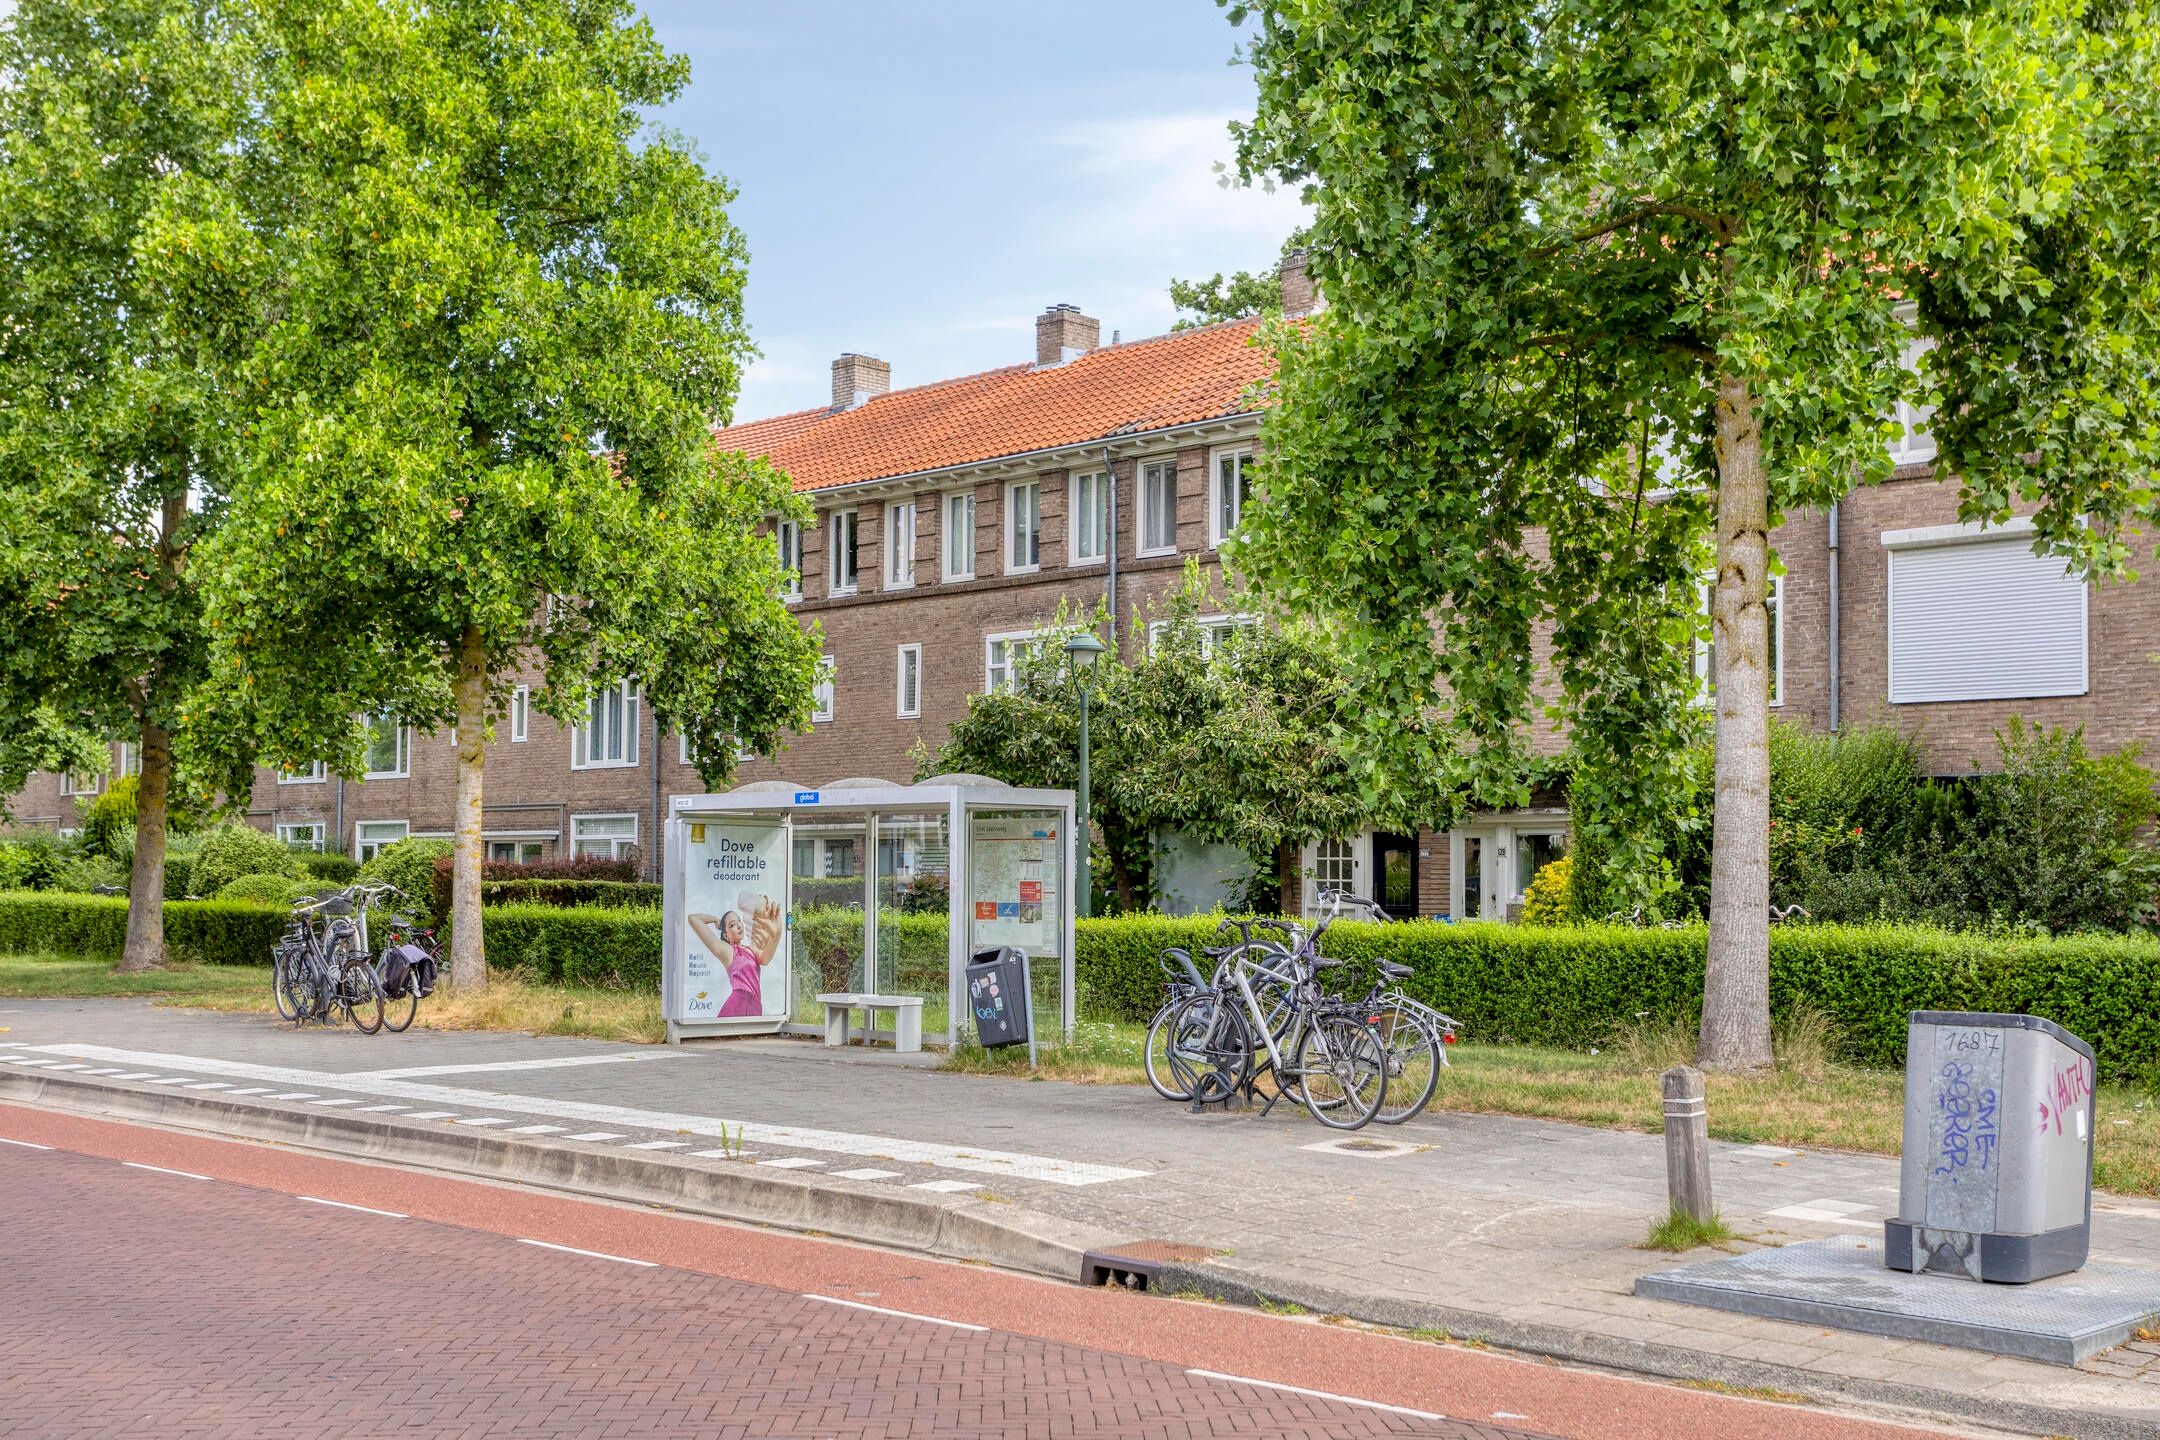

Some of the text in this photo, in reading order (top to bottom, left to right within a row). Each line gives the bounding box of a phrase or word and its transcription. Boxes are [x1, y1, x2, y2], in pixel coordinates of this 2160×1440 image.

[800, 793, 815, 803] global
[721, 838, 754, 852] Dove
[707, 855, 766, 869] refillable
[713, 870, 760, 881] deodorant
[688, 953, 704, 961] Refill
[688, 961, 708, 969] Reuse
[688, 969, 711, 978] Repeat
[688, 998, 713, 1010] Dove
[1945, 1031, 1999, 1057] 1687
